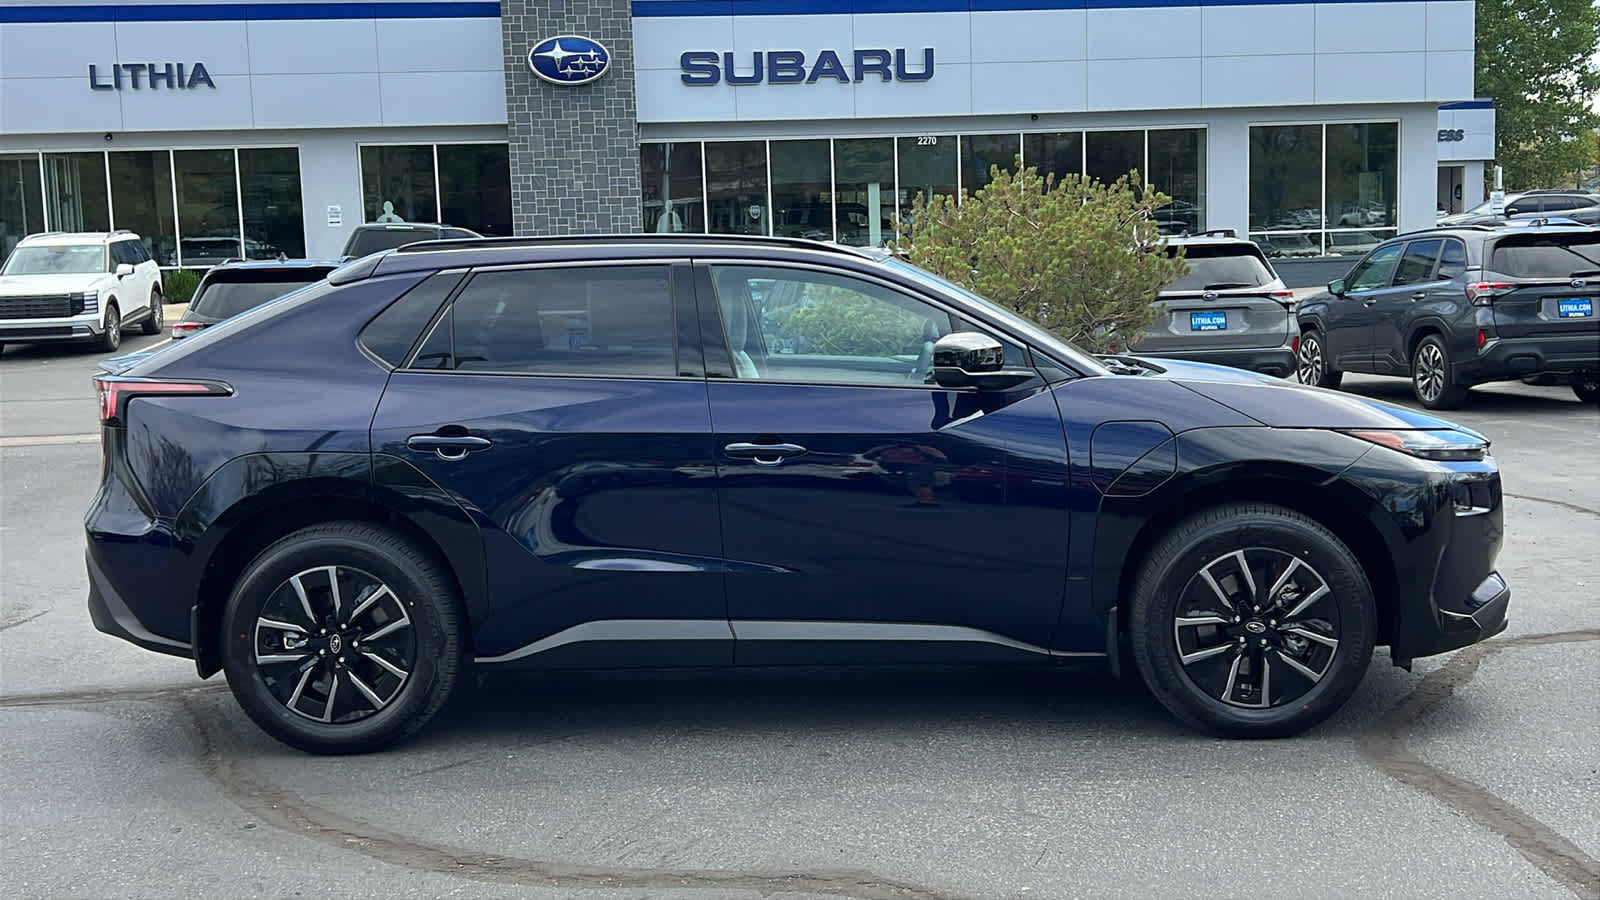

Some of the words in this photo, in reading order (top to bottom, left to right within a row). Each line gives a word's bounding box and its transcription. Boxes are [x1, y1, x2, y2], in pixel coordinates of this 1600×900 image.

[88, 62, 216, 90] LITHIA
[680, 48, 935, 86] SUBARU
[917, 136, 937, 145] 2270
